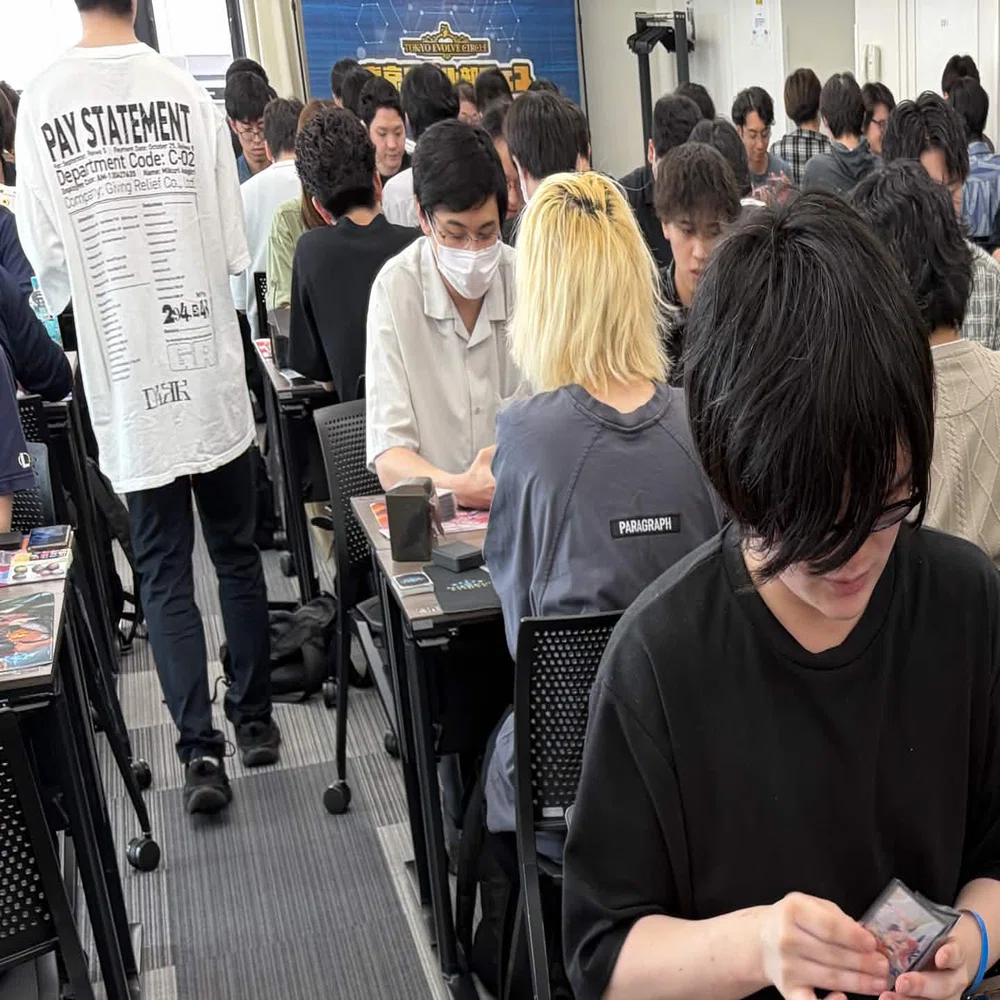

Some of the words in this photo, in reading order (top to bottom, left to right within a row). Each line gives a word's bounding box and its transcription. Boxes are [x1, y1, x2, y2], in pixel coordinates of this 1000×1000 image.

[404, 43, 431, 53] TOKYO
[41, 112, 81, 162] PAY
[81, 101, 191, 148] STATEMENT
[56, 154, 127, 186] Department
[128, 151, 166, 169] Code:
[168, 149, 196, 167] C-02
[619, 516, 672, 535] PARAGRAPH
